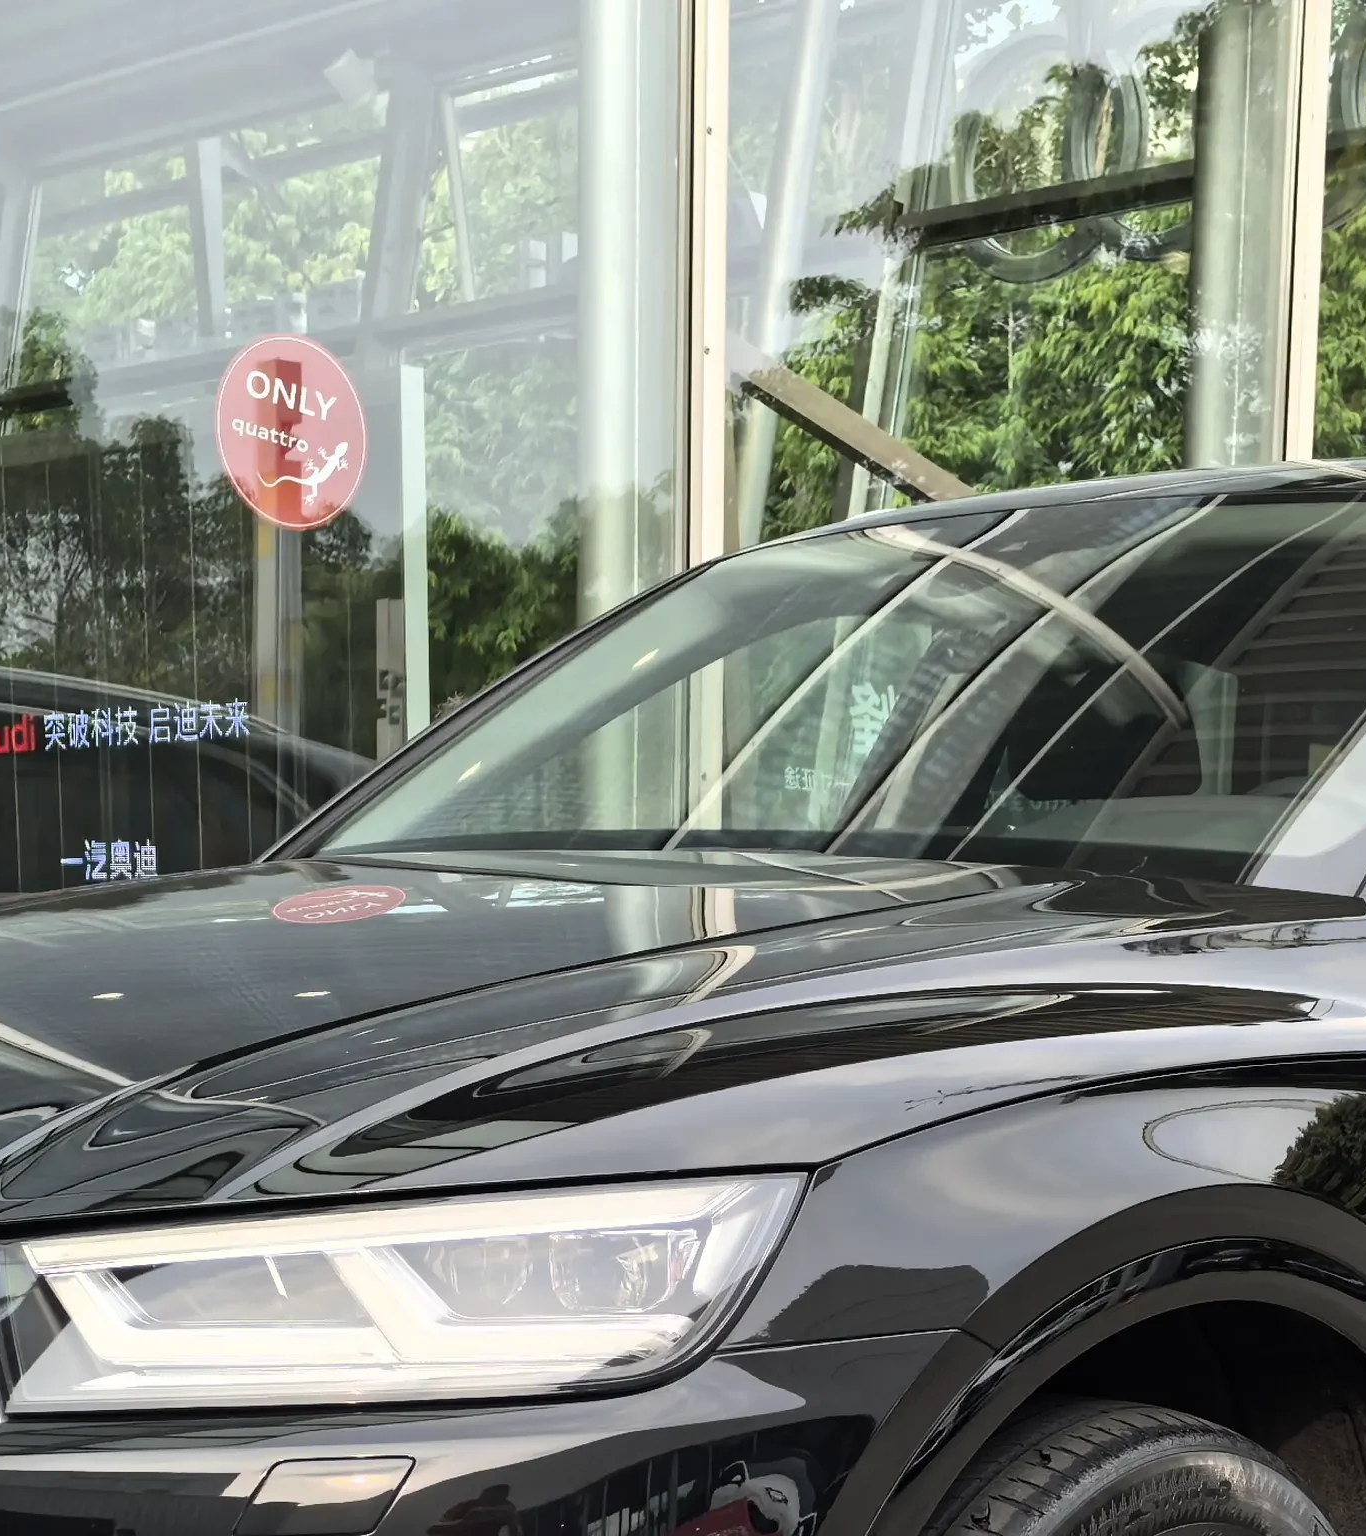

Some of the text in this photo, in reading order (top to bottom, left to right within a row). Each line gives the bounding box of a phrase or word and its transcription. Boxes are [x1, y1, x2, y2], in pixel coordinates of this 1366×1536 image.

[246, 370, 337, 421] ONLY
[232, 418, 309, 453] quattro
[43, 706, 139, 751] 突破科技
[149, 698, 251, 744] 启迪未来
[60, 838, 158, 880] 一汽奥迪
